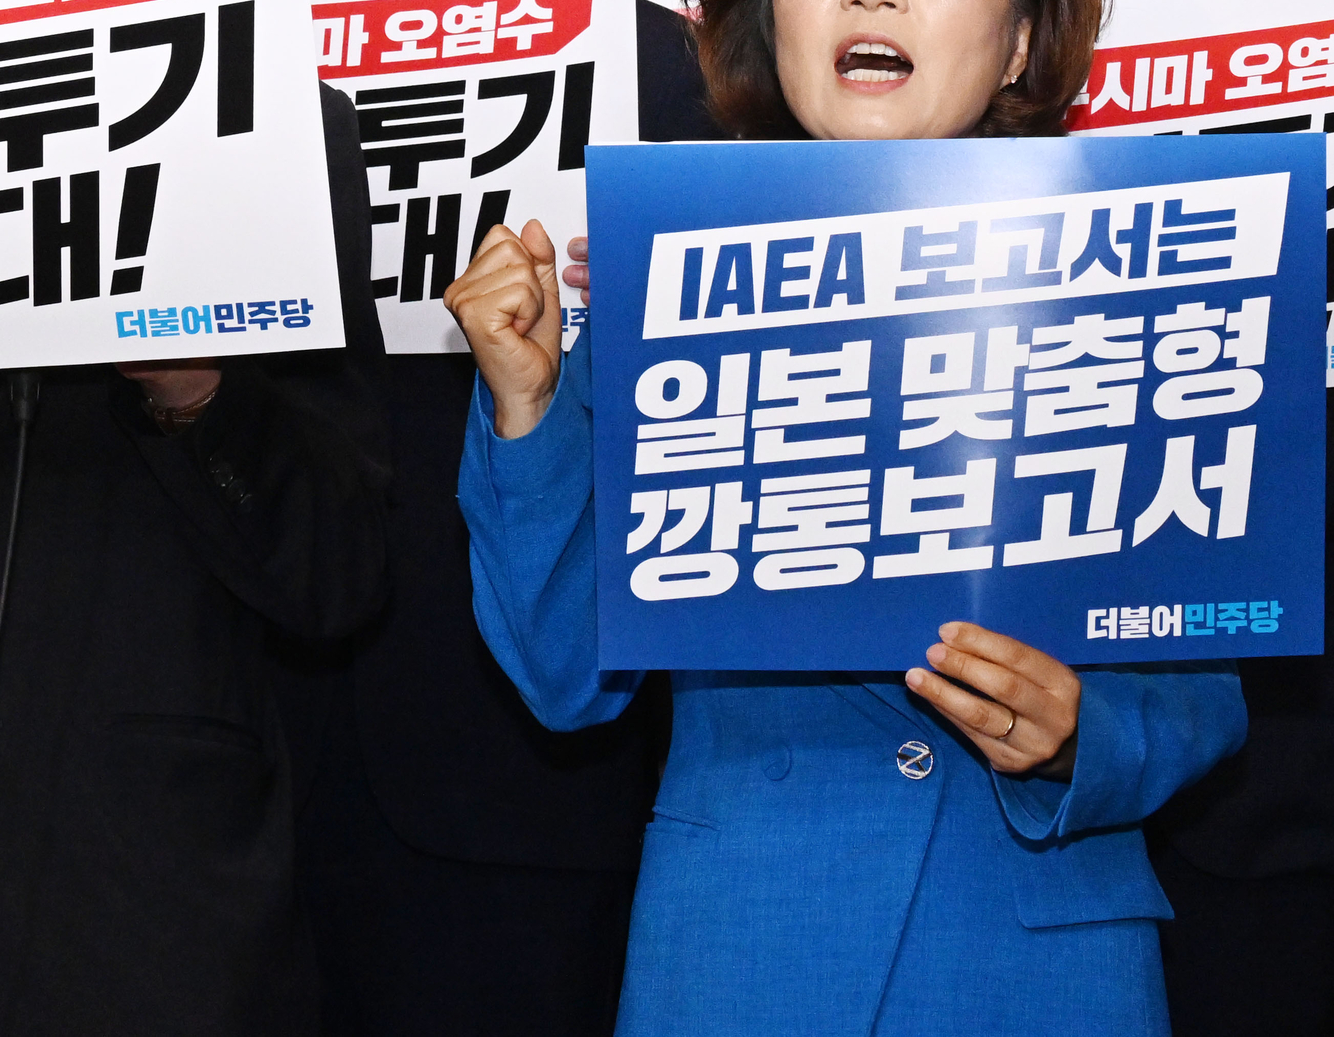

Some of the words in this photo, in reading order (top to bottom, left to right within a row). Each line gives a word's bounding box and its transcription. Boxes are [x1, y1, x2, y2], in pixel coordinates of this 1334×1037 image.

[353, 60, 596, 191] 투기
[1069, 50, 1213, 116] 시마
[114, 297, 315, 341] 더불어민주당
[677, 230, 867, 322] IAEA
[894, 198, 1238, 302] 보고서는
[632, 338, 872, 476] 일본
[899, 296, 1273, 451] 맞춤형
[625, 425, 1259, 602] 깡통보고서
[1085, 599, 1285, 641] 더불어민주당
